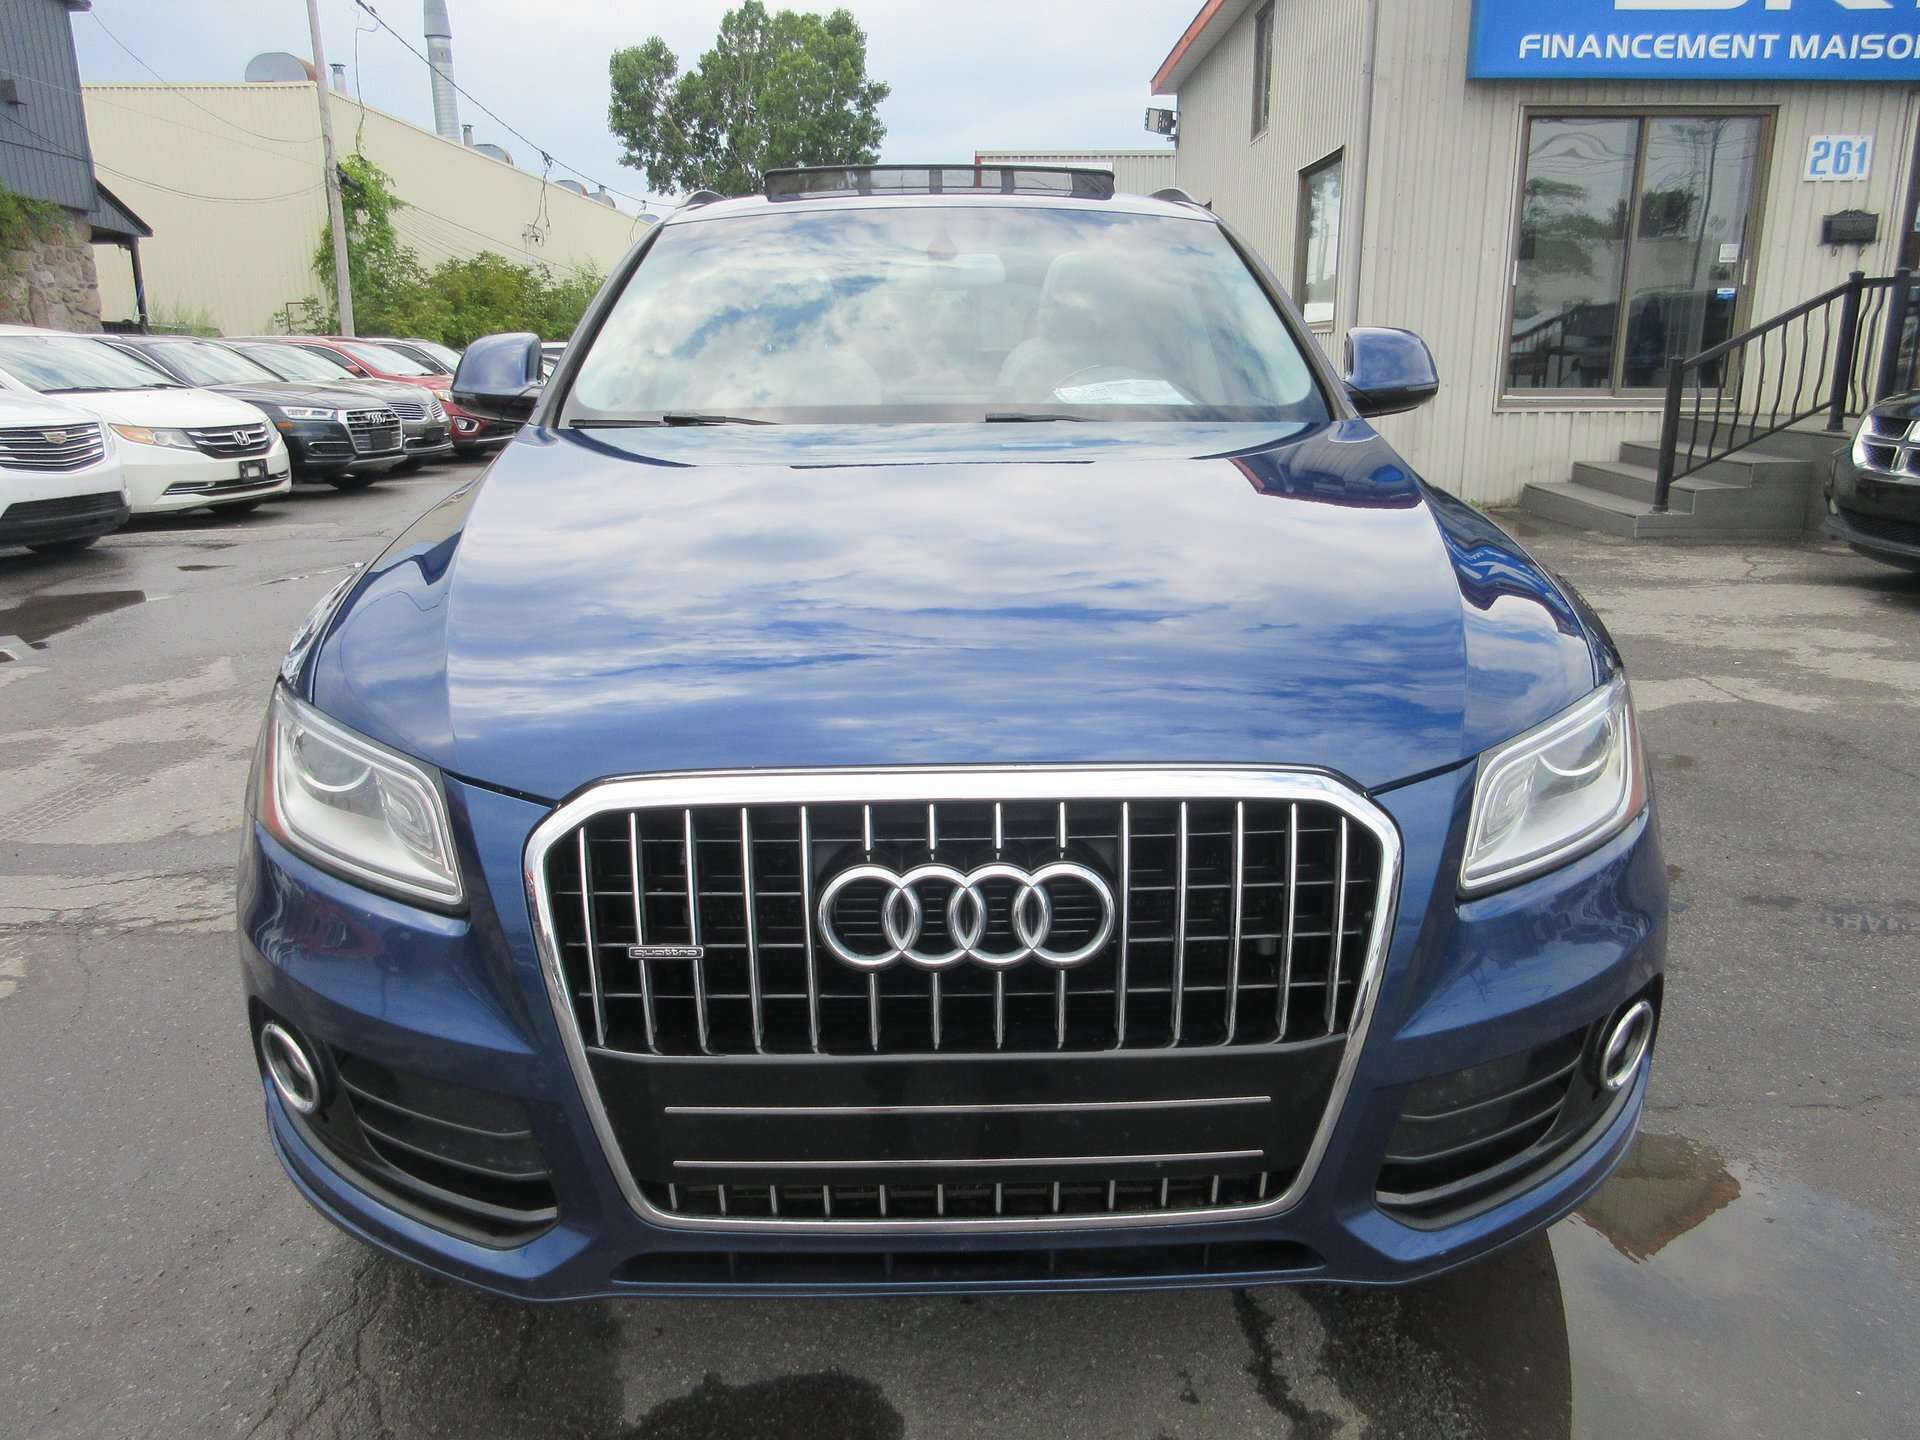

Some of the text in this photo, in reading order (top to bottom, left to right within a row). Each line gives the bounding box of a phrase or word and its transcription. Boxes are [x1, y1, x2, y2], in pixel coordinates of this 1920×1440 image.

[1518, 33, 1920, 60] FINANCEMENT MAISO
[1809, 140, 1867, 175] 261
[633, 948, 698, 957] quattro
